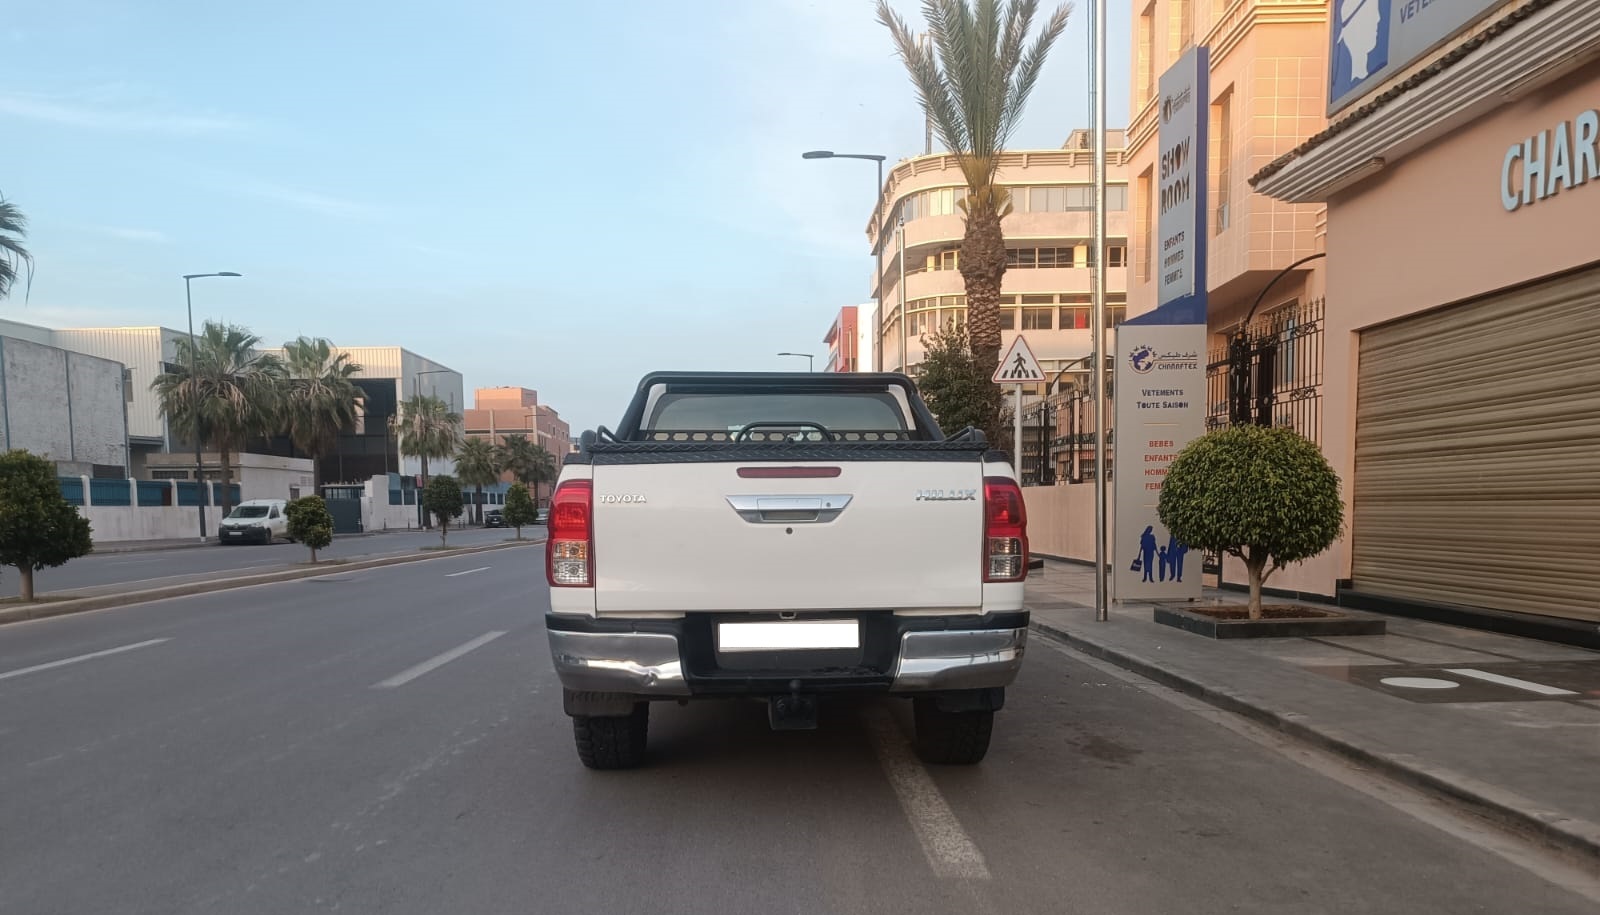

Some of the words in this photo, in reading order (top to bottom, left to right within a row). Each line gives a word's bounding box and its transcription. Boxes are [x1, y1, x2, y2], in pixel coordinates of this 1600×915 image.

[1161, 135, 1191, 181] SHOW
[1501, 109, 1600, 212] CHAR
[1161, 171, 1190, 217] ROOM
[1164, 230, 1185, 251] ENFANTS
[1141, 389, 1184, 397] VETEMENTS
[1136, 401, 1161, 409] TOUTE
[1162, 401, 1189, 409] SAISON
[1149, 440, 1174, 448] BEBES
[1144, 468, 1169, 476] HOMM
[599, 494, 648, 504] TOYOTA
[915, 489, 977, 501] HILUX
